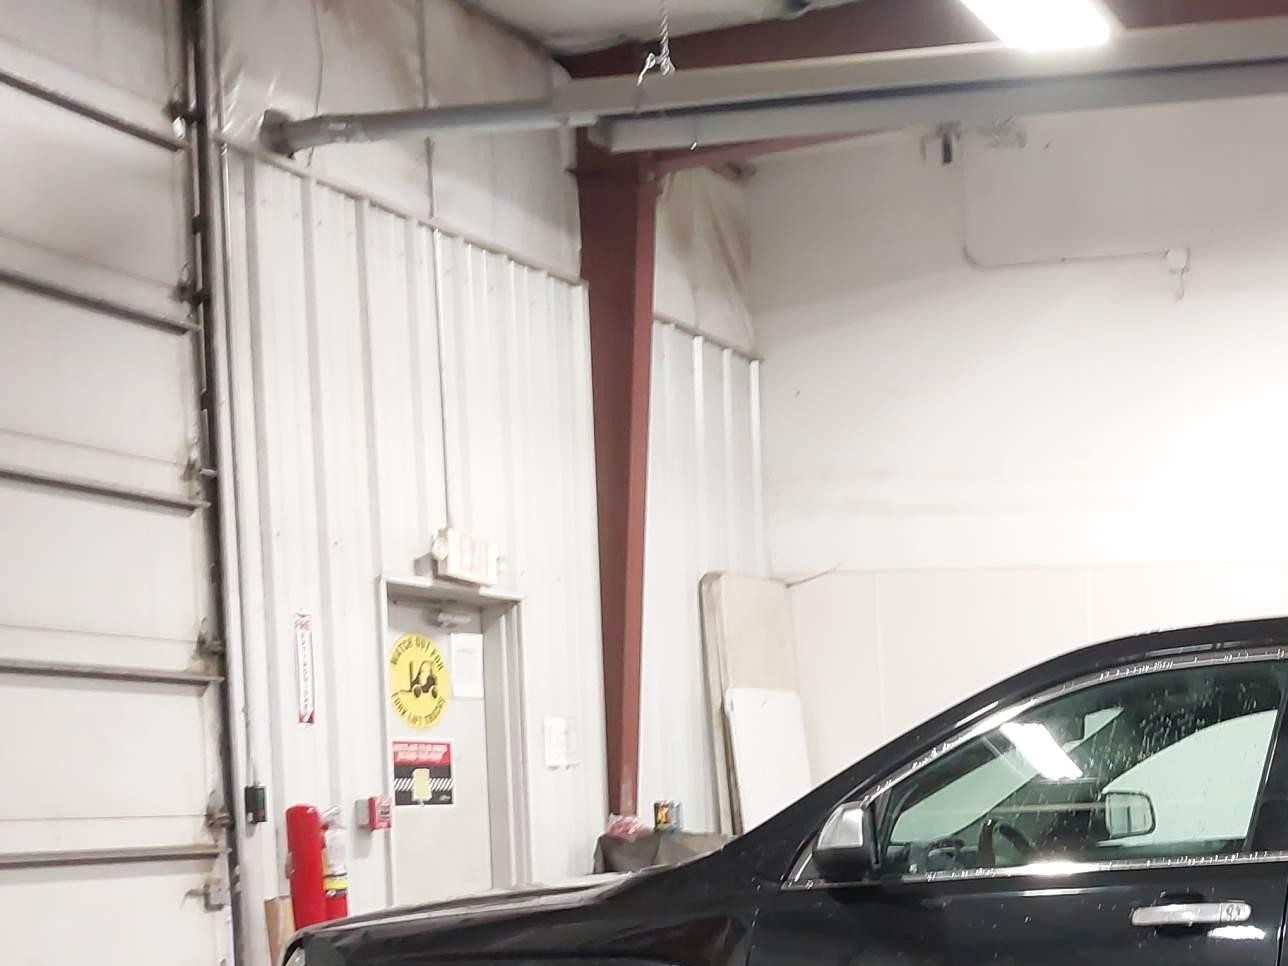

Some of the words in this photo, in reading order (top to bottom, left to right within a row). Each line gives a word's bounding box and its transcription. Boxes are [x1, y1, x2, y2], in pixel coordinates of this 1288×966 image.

[390, 636, 413, 665] WATCH
[415, 636, 431, 652] OUT
[430, 648, 445, 671] FOR
